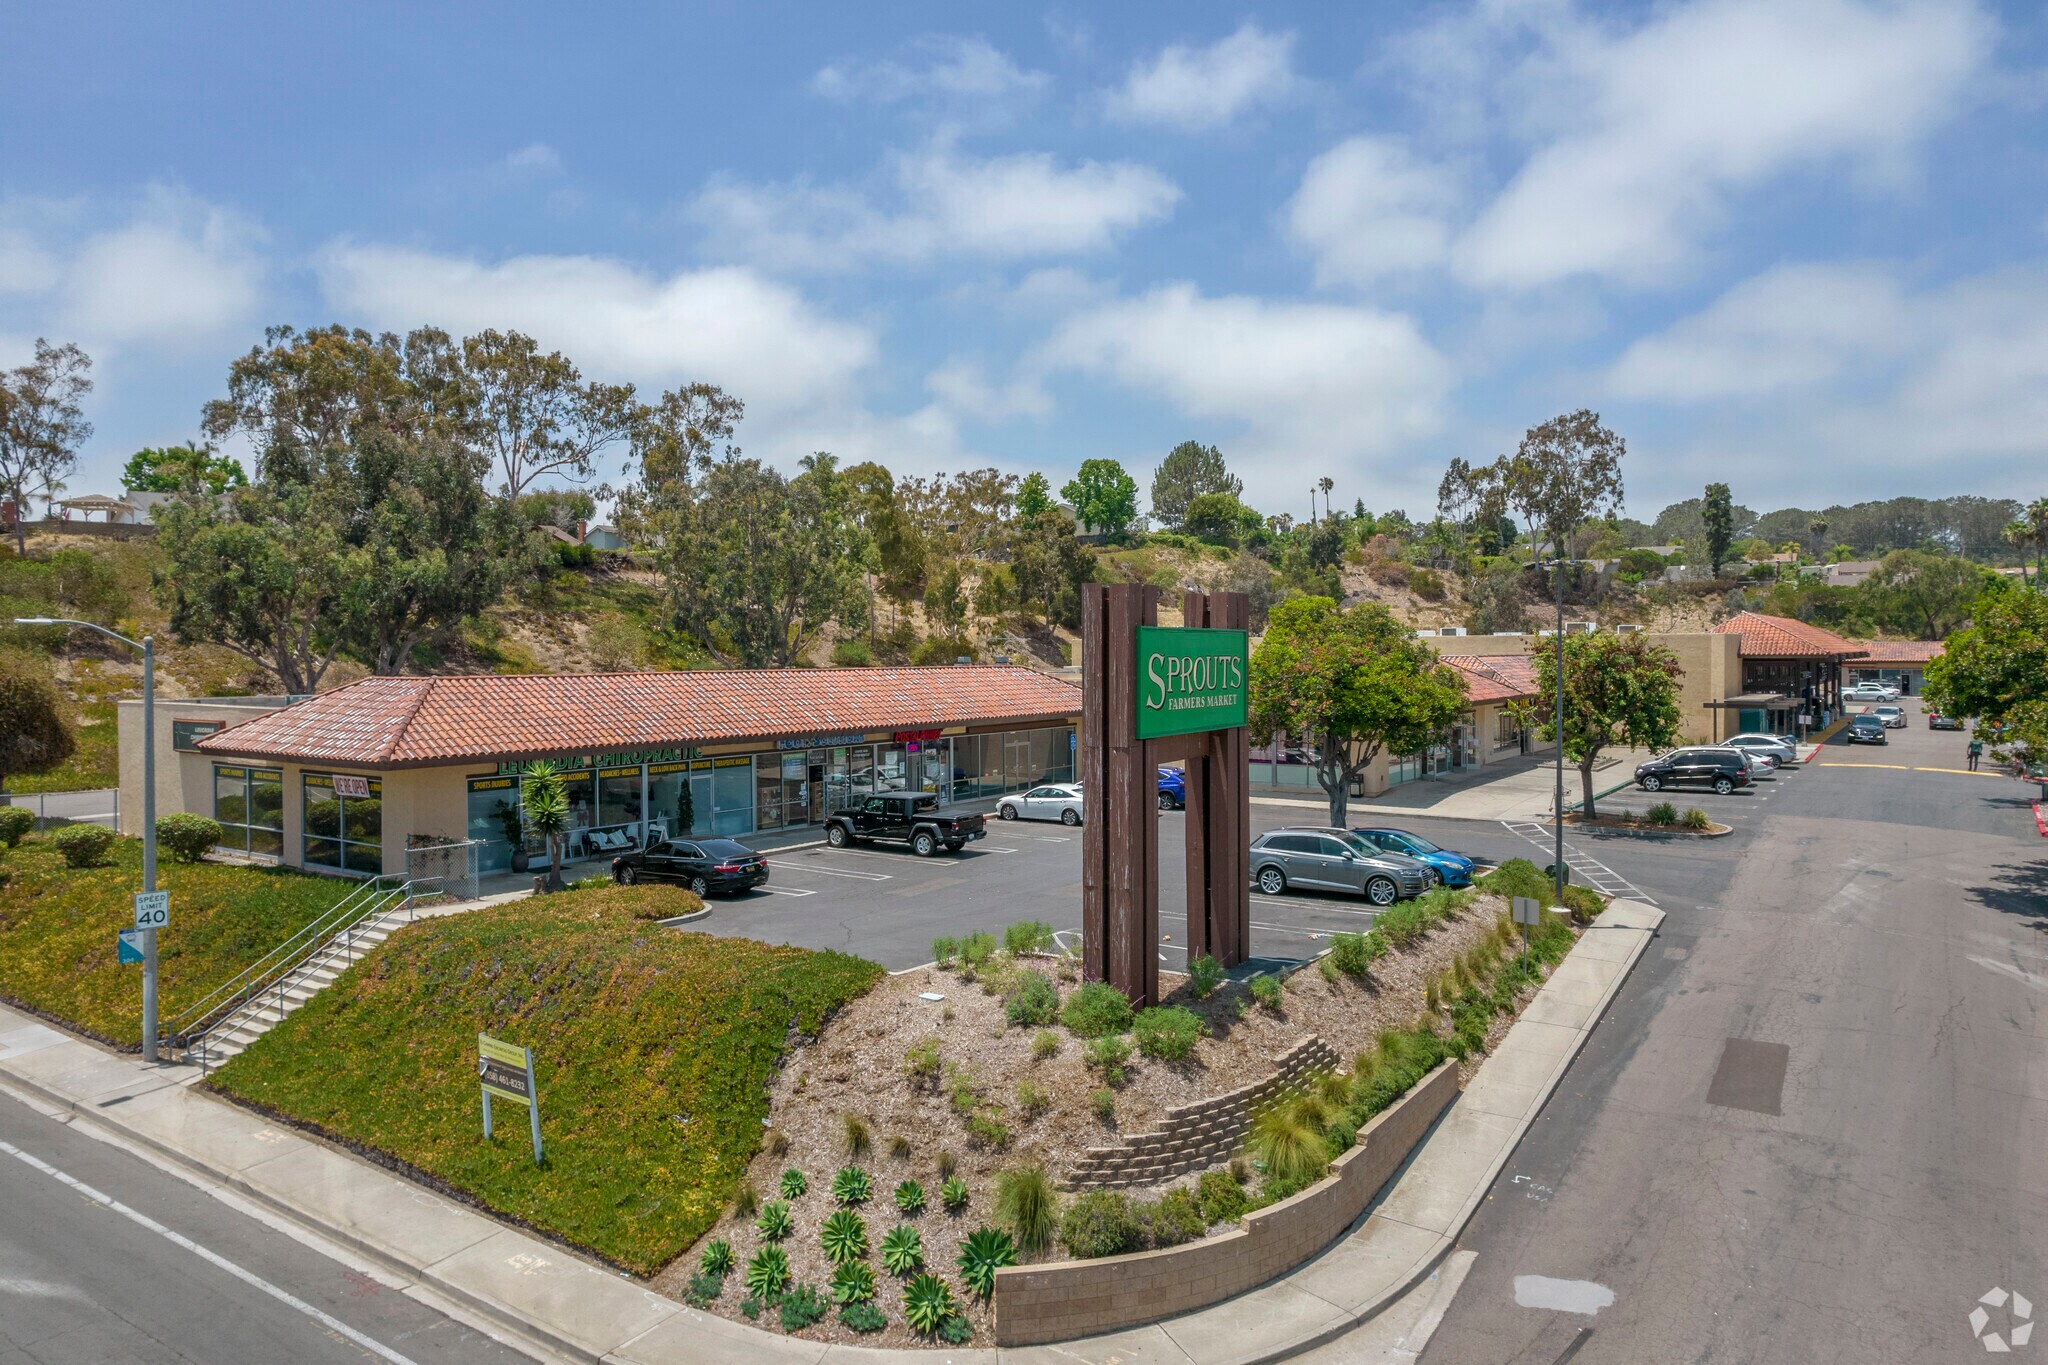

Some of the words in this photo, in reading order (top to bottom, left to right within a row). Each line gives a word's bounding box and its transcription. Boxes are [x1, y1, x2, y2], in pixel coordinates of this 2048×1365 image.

[1146, 652, 1242, 710] SPROUTS
[1168, 696, 1205, 710] FARMERS
[1207, 695, 1237, 707] MARKET
[498, 755, 585, 775] LEUDIA
[593, 746, 703, 768] CHIROPRACTIC
[334, 777, 352, 794] WE'RE
[352, 778, 368, 795] OPEN
[473, 781, 491, 790] SPORTS
[138, 895, 166, 903] SPEED
[141, 902, 162, 911] LIMIT
[138, 910, 166, 924] 40
[499, 1074, 526, 1091] 461-8232
